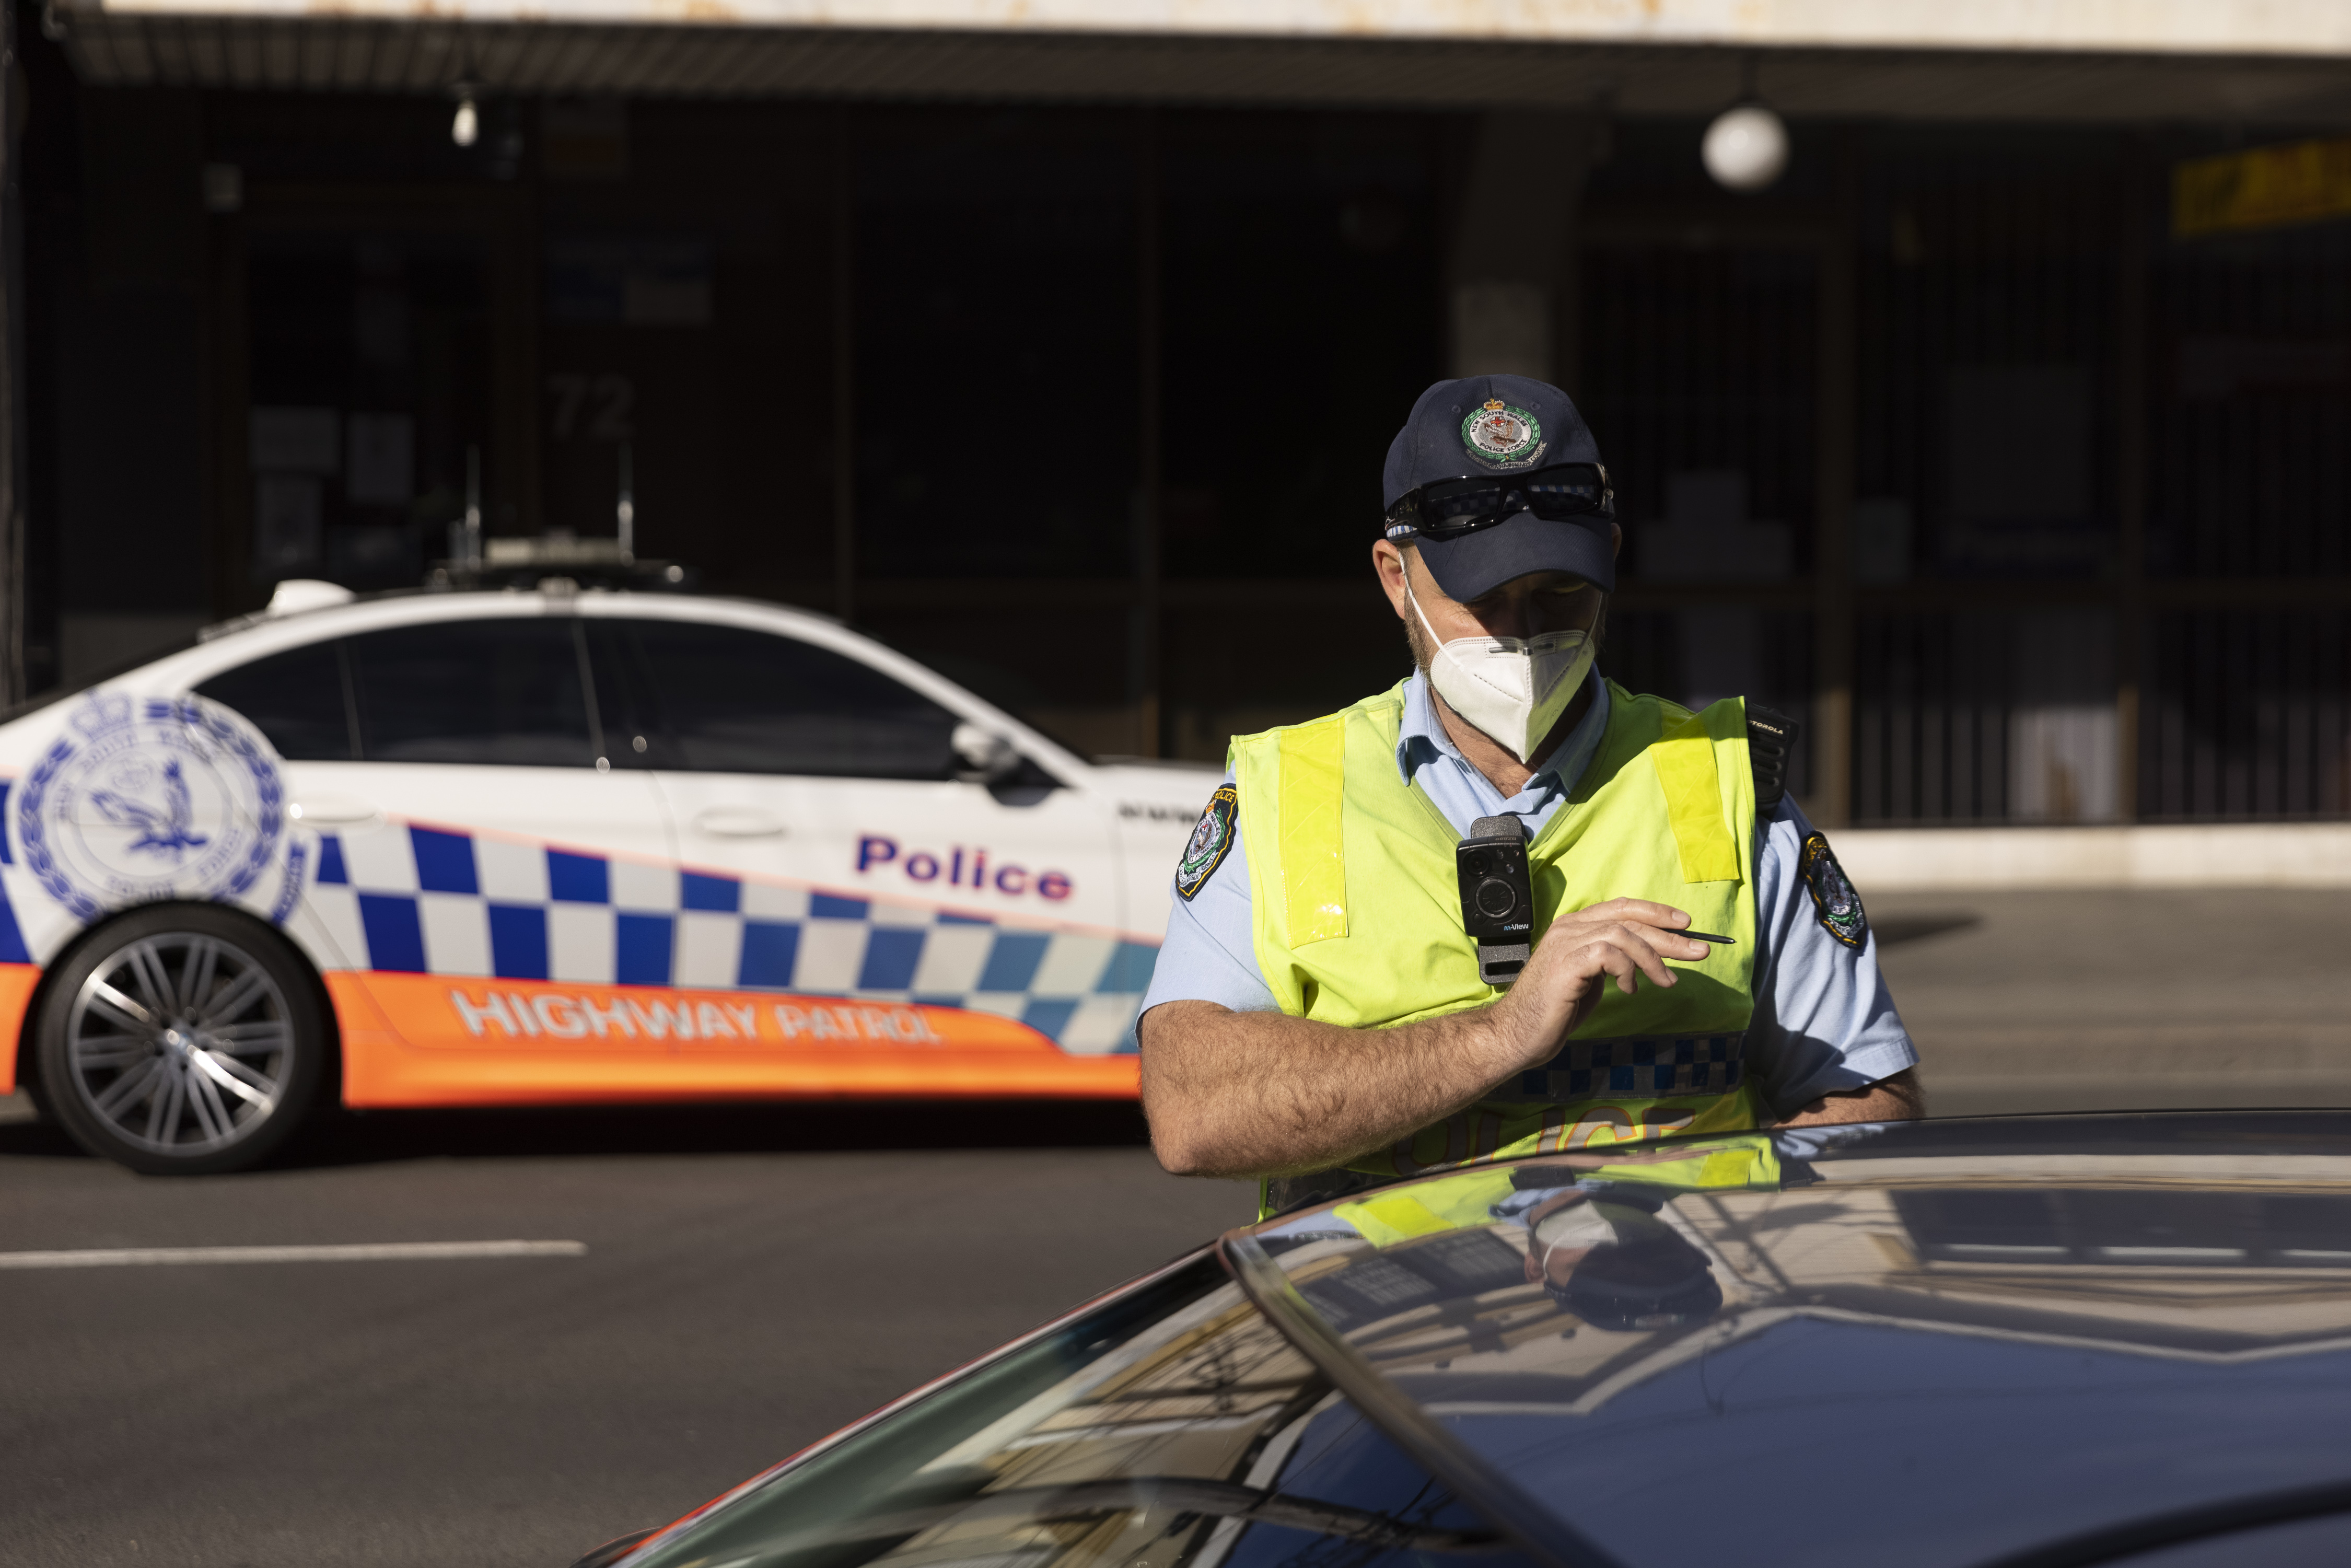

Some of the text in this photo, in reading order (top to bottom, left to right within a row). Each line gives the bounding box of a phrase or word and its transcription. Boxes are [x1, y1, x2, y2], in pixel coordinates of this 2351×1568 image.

[549, 373, 633, 438] 72
[1471, 411, 1528, 432] NEW SOUTH WALES
[1480, 439, 1527, 452] POLICE FORCE
[1747, 719, 1784, 735] OTOROLA
[1215, 791, 1235, 803] POLICE
[856, 837, 1072, 901] Police
[449, 989, 942, 1044] HIGHWAY PATROL
